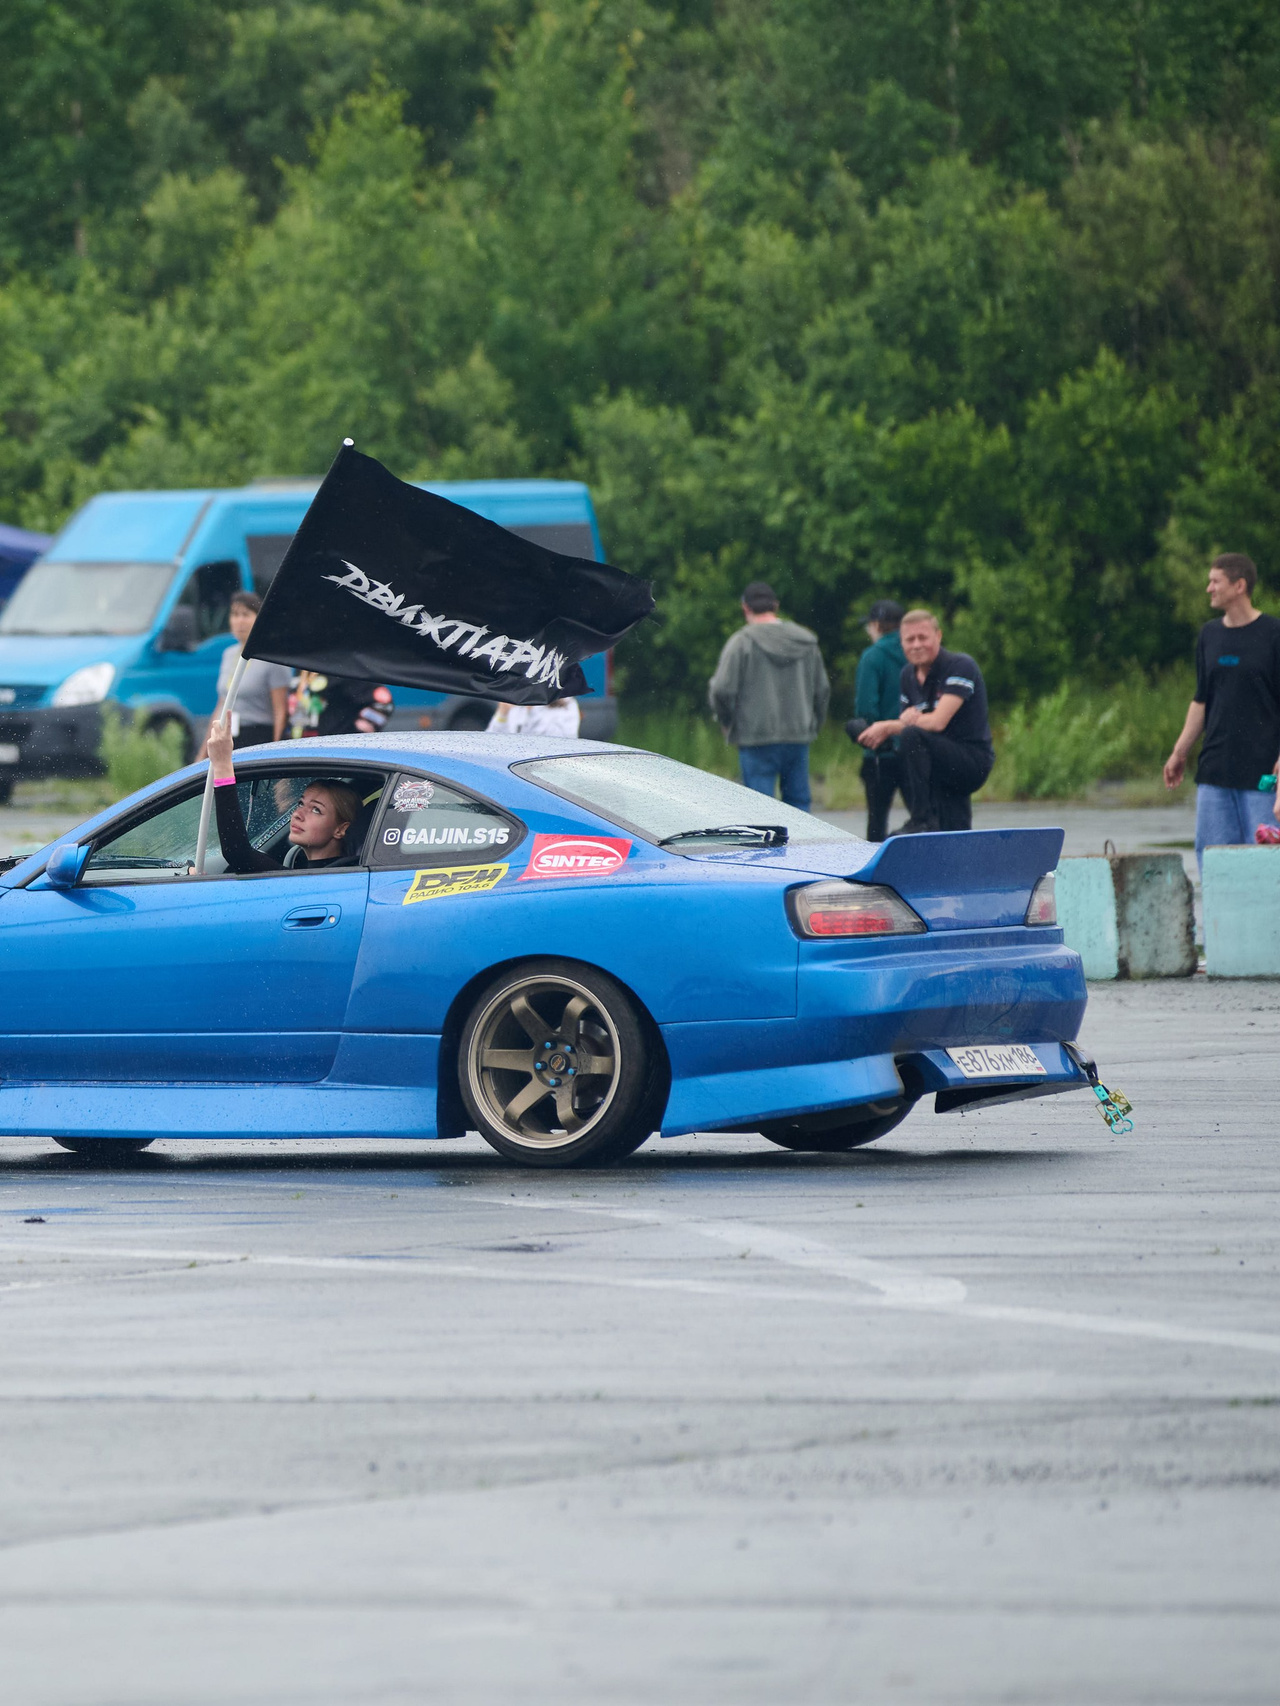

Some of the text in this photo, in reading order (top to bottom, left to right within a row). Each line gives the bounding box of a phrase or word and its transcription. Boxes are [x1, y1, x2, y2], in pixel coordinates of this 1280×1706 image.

[402, 827, 510, 845] GAIJIN.S15
[538, 855, 617, 868] SINTEC
[414, 868, 503, 892] DFM
[409, 882, 491, 901] РАДИО 104.6
[1011, 1046, 1036, 1065] 186
